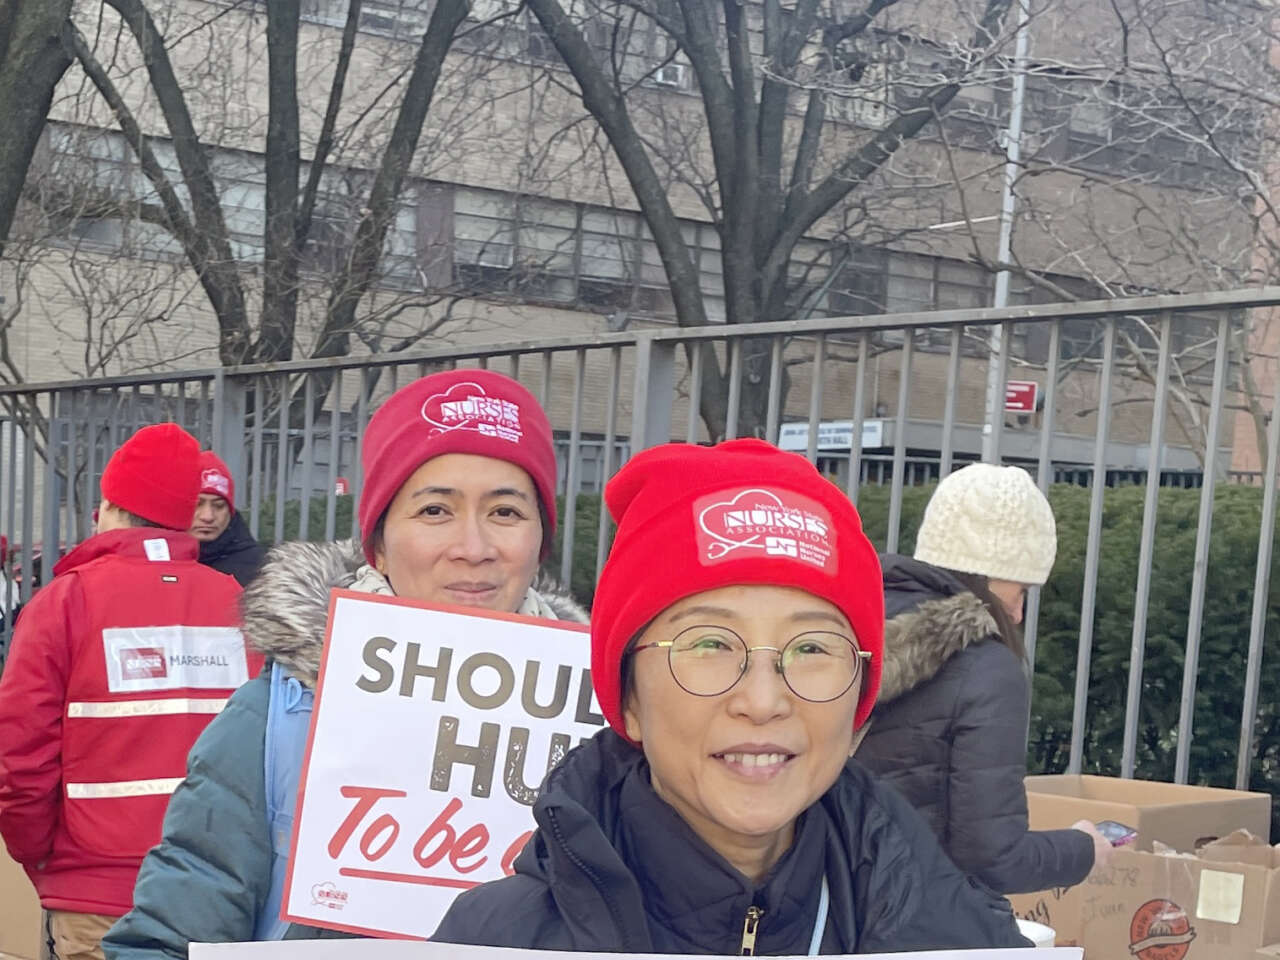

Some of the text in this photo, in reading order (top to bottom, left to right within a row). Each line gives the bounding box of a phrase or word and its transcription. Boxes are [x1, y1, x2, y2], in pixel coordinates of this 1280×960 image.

[440, 399, 520, 424] NURSES
[723, 510, 829, 537] NURSES
[726, 525, 832, 550] ASSOCIATION
[170, 655, 229, 667] MARSHALL
[430, 715, 588, 807] HU
[328, 785, 408, 860] To
[413, 797, 490, 874] be
